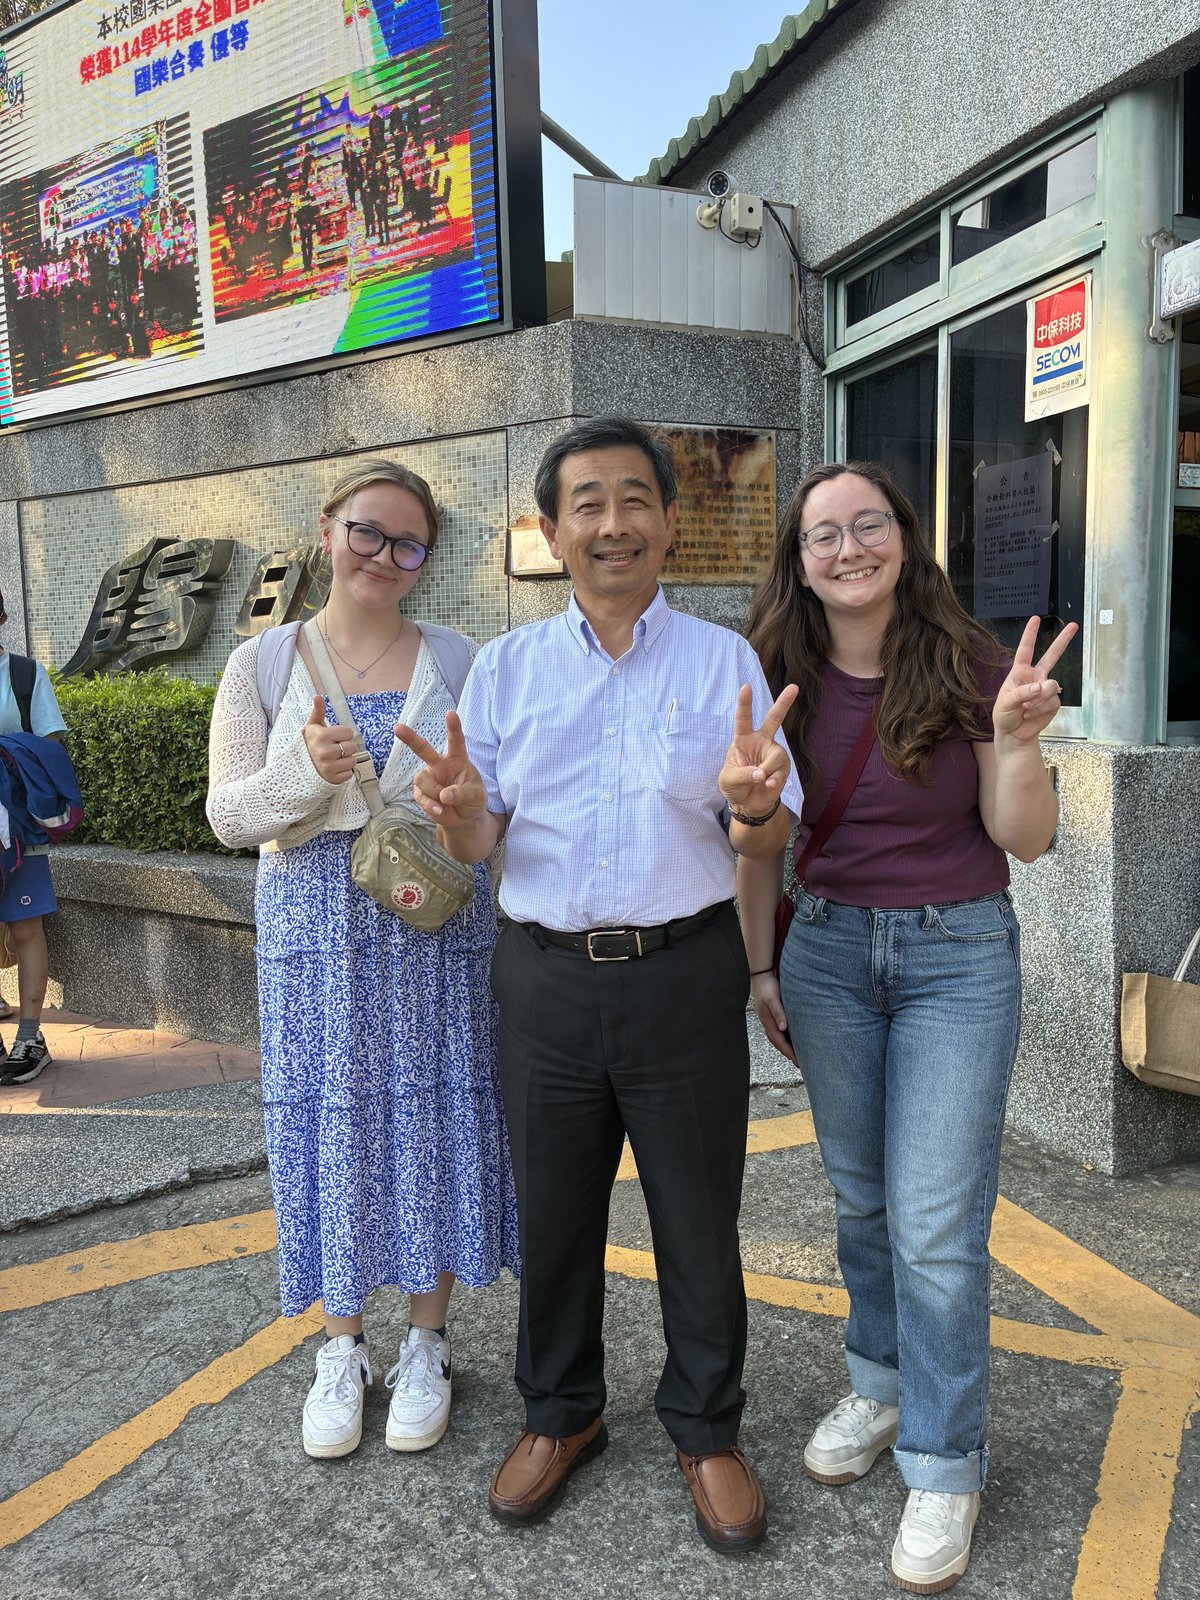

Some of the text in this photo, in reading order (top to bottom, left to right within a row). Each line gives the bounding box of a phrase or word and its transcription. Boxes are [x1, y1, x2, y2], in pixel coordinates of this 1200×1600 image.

[1037, 311, 1082, 342] 中保科技
[1036, 342, 1080, 372] SECOM
